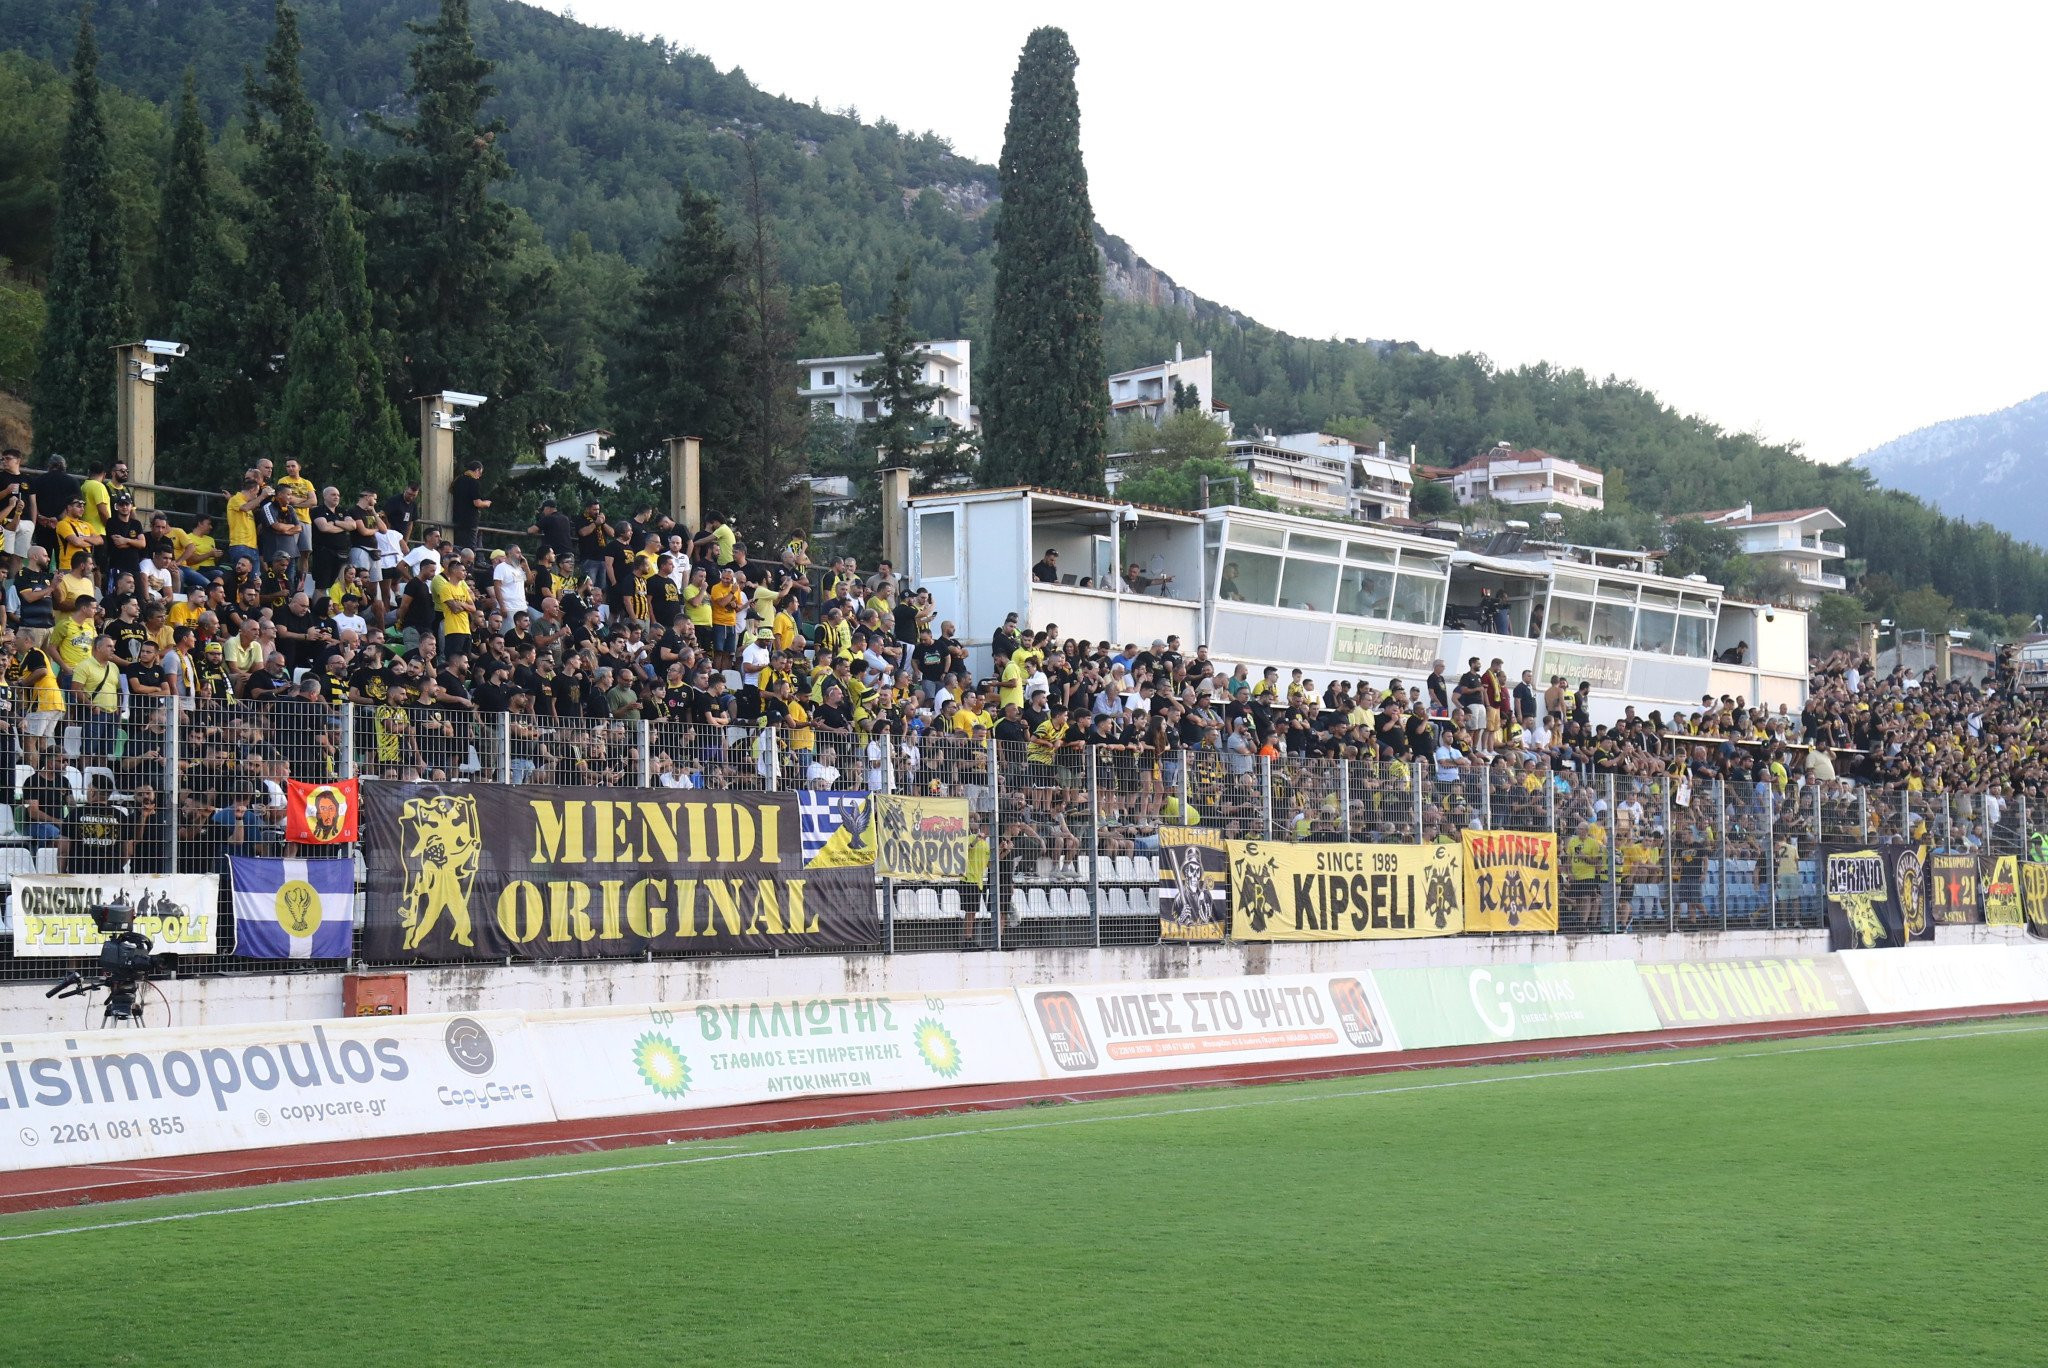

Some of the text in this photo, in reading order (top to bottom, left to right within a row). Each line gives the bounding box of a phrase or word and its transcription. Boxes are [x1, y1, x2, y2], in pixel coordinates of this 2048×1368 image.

[1337, 636, 1436, 664] www.levadiakosfc.gr
[1544, 660, 1624, 682] www.levadiakosfc.gr
[529, 800, 782, 864] MENIDI
[1159, 826, 1227, 850] ORIGINAL
[884, 838, 967, 875] OROPOS
[1316, 852, 1398, 873] SINCE 1989
[1472, 834, 1552, 871] ΠΛΑΤΑΙΕΣ
[1829, 858, 1884, 893] AGRINIO
[1293, 873, 1416, 931] KIPSELI
[1528, 878, 1552, 912] 21
[1933, 875, 1977, 906] R 21
[496, 878, 820, 943] ORIGINAL
[924, 994, 945, 1015] bp
[1509, 979, 1576, 1004] GONIAS
[1639, 958, 1840, 1024] ΤΖΟΥΝΑΡΑΣ
[648, 1006, 674, 1029] bp
[696, 997, 899, 1041] ΒΥΛΛΙΩΤΗΣ
[1096, 986, 1325, 1038] ΜΠΕΣ ΣΤΟ ΨΗΤΟ
[1348, 1030, 1374, 1044] ΨΗΤΟ
[709, 1043, 903, 1070] ΣΤΑΘΜΟΣ ΕΞΥΠΗΡΕΤΗΣΗΣ
[1057, 1051, 1087, 1066] ΨΗΤΟ
[437, 1081, 534, 1109] CopyCare
[767, 1071, 872, 1093] ΑΥΤΟΚΙΝΗΤΩΝ
[280, 1097, 387, 1122] copycare.gr
[50, 1116, 185, 1144] 2261 081 855
